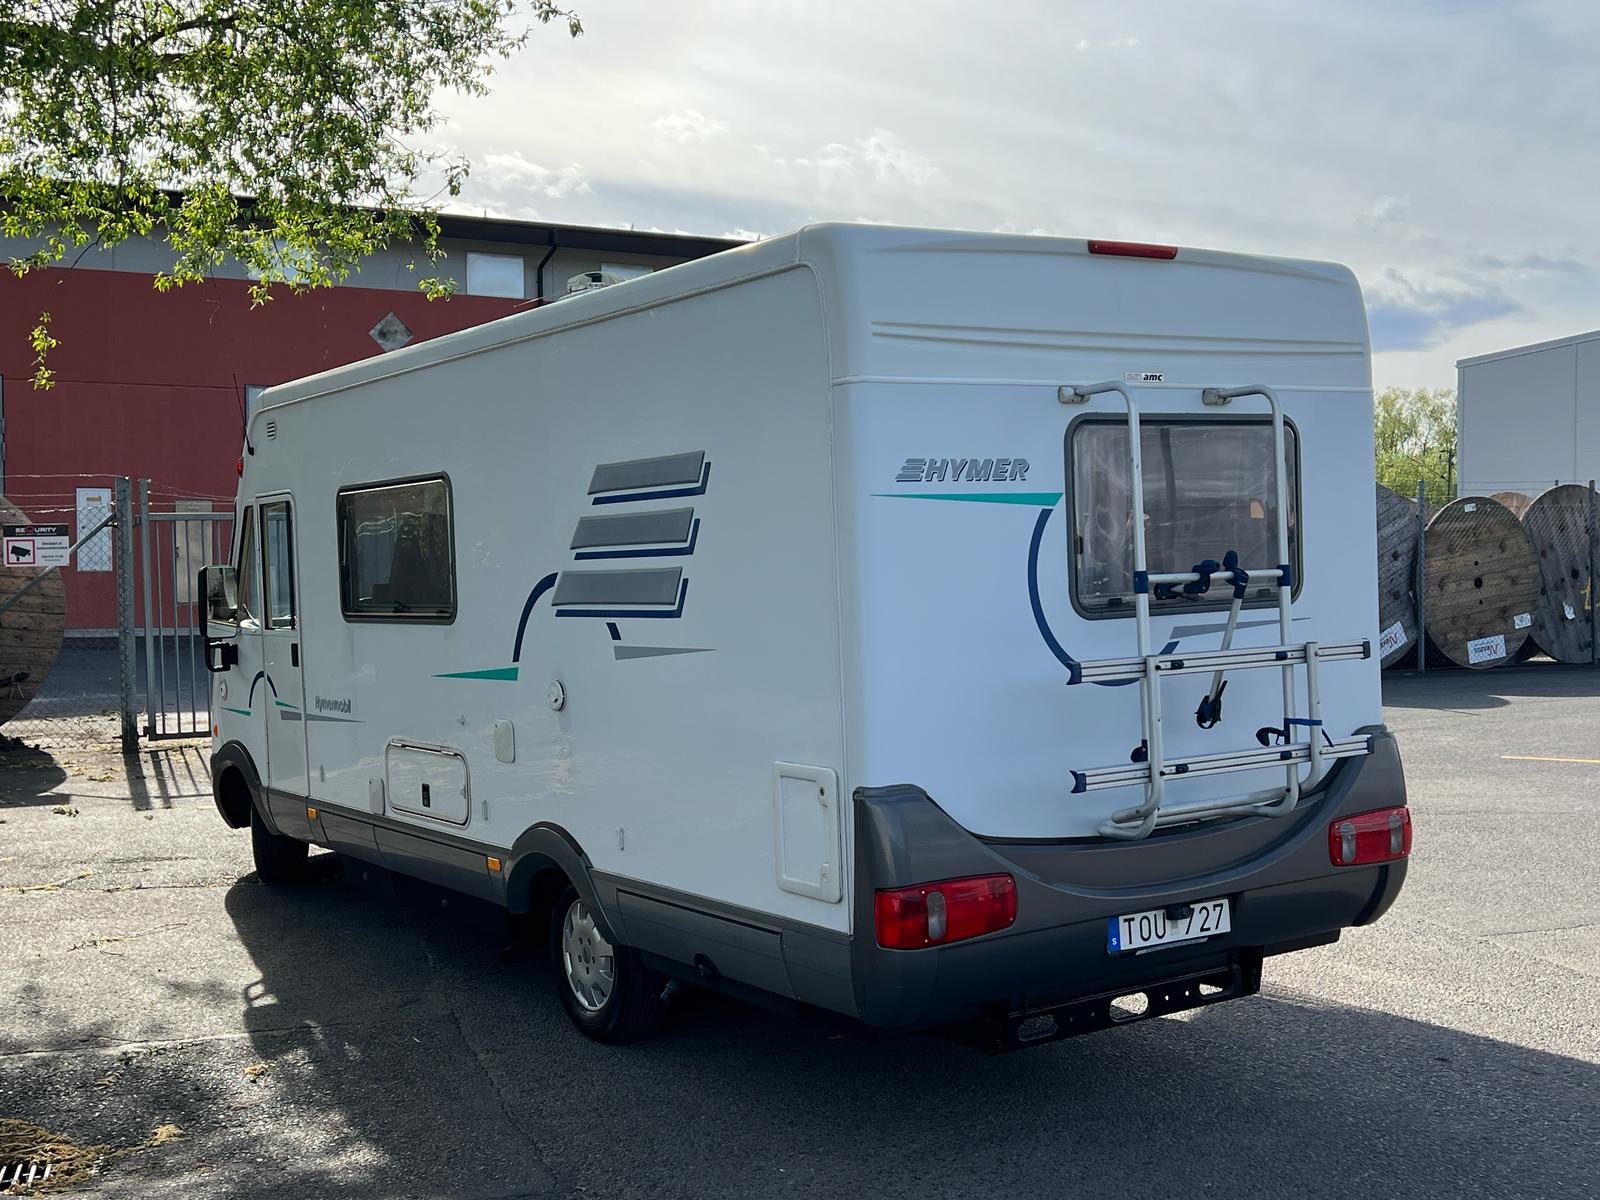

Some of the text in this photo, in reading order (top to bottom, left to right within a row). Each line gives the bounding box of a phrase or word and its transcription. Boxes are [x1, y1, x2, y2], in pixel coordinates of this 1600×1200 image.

[1143, 373, 1163, 382] amc
[923, 457, 1031, 483] HYMER
[1123, 911, 1167, 945] TOU
[1111, 937, 1118, 946] S
